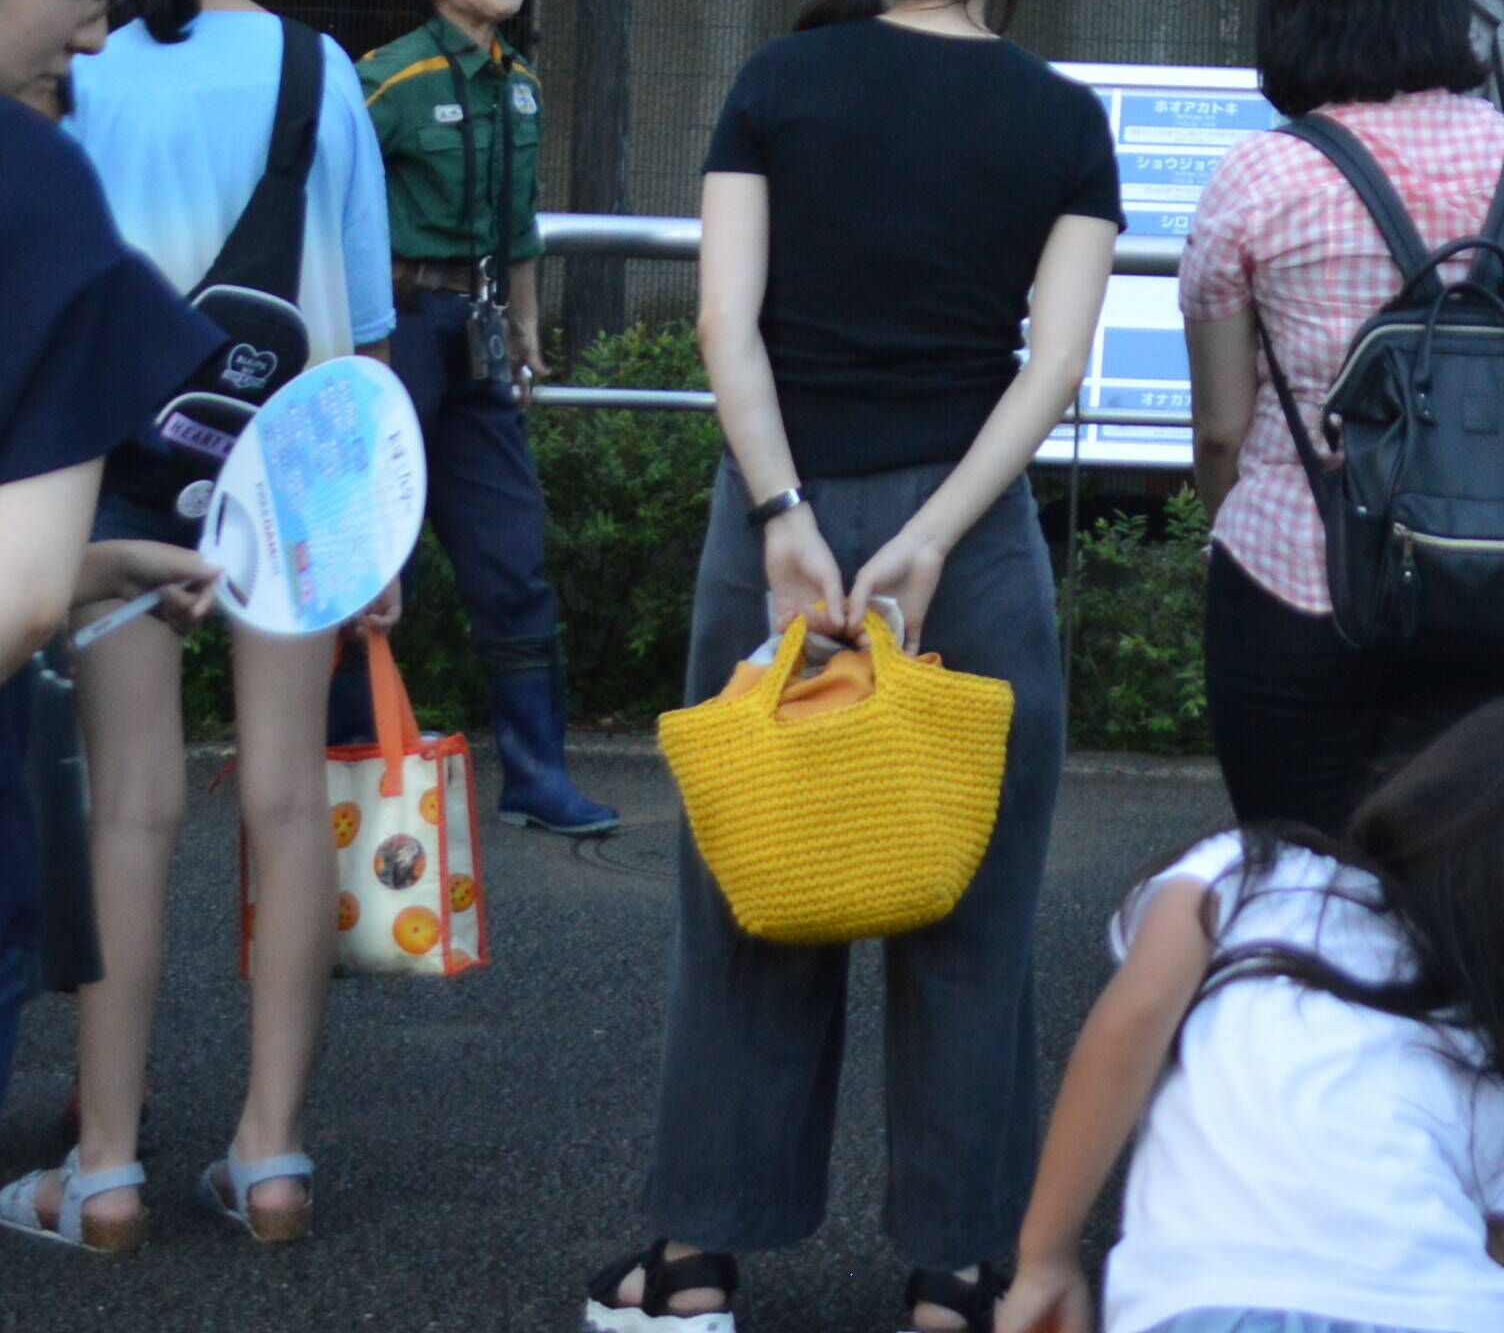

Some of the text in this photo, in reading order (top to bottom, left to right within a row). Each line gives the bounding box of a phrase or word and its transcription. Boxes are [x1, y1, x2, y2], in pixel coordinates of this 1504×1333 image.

[1154, 100, 1239, 116] ホオアカトキ
